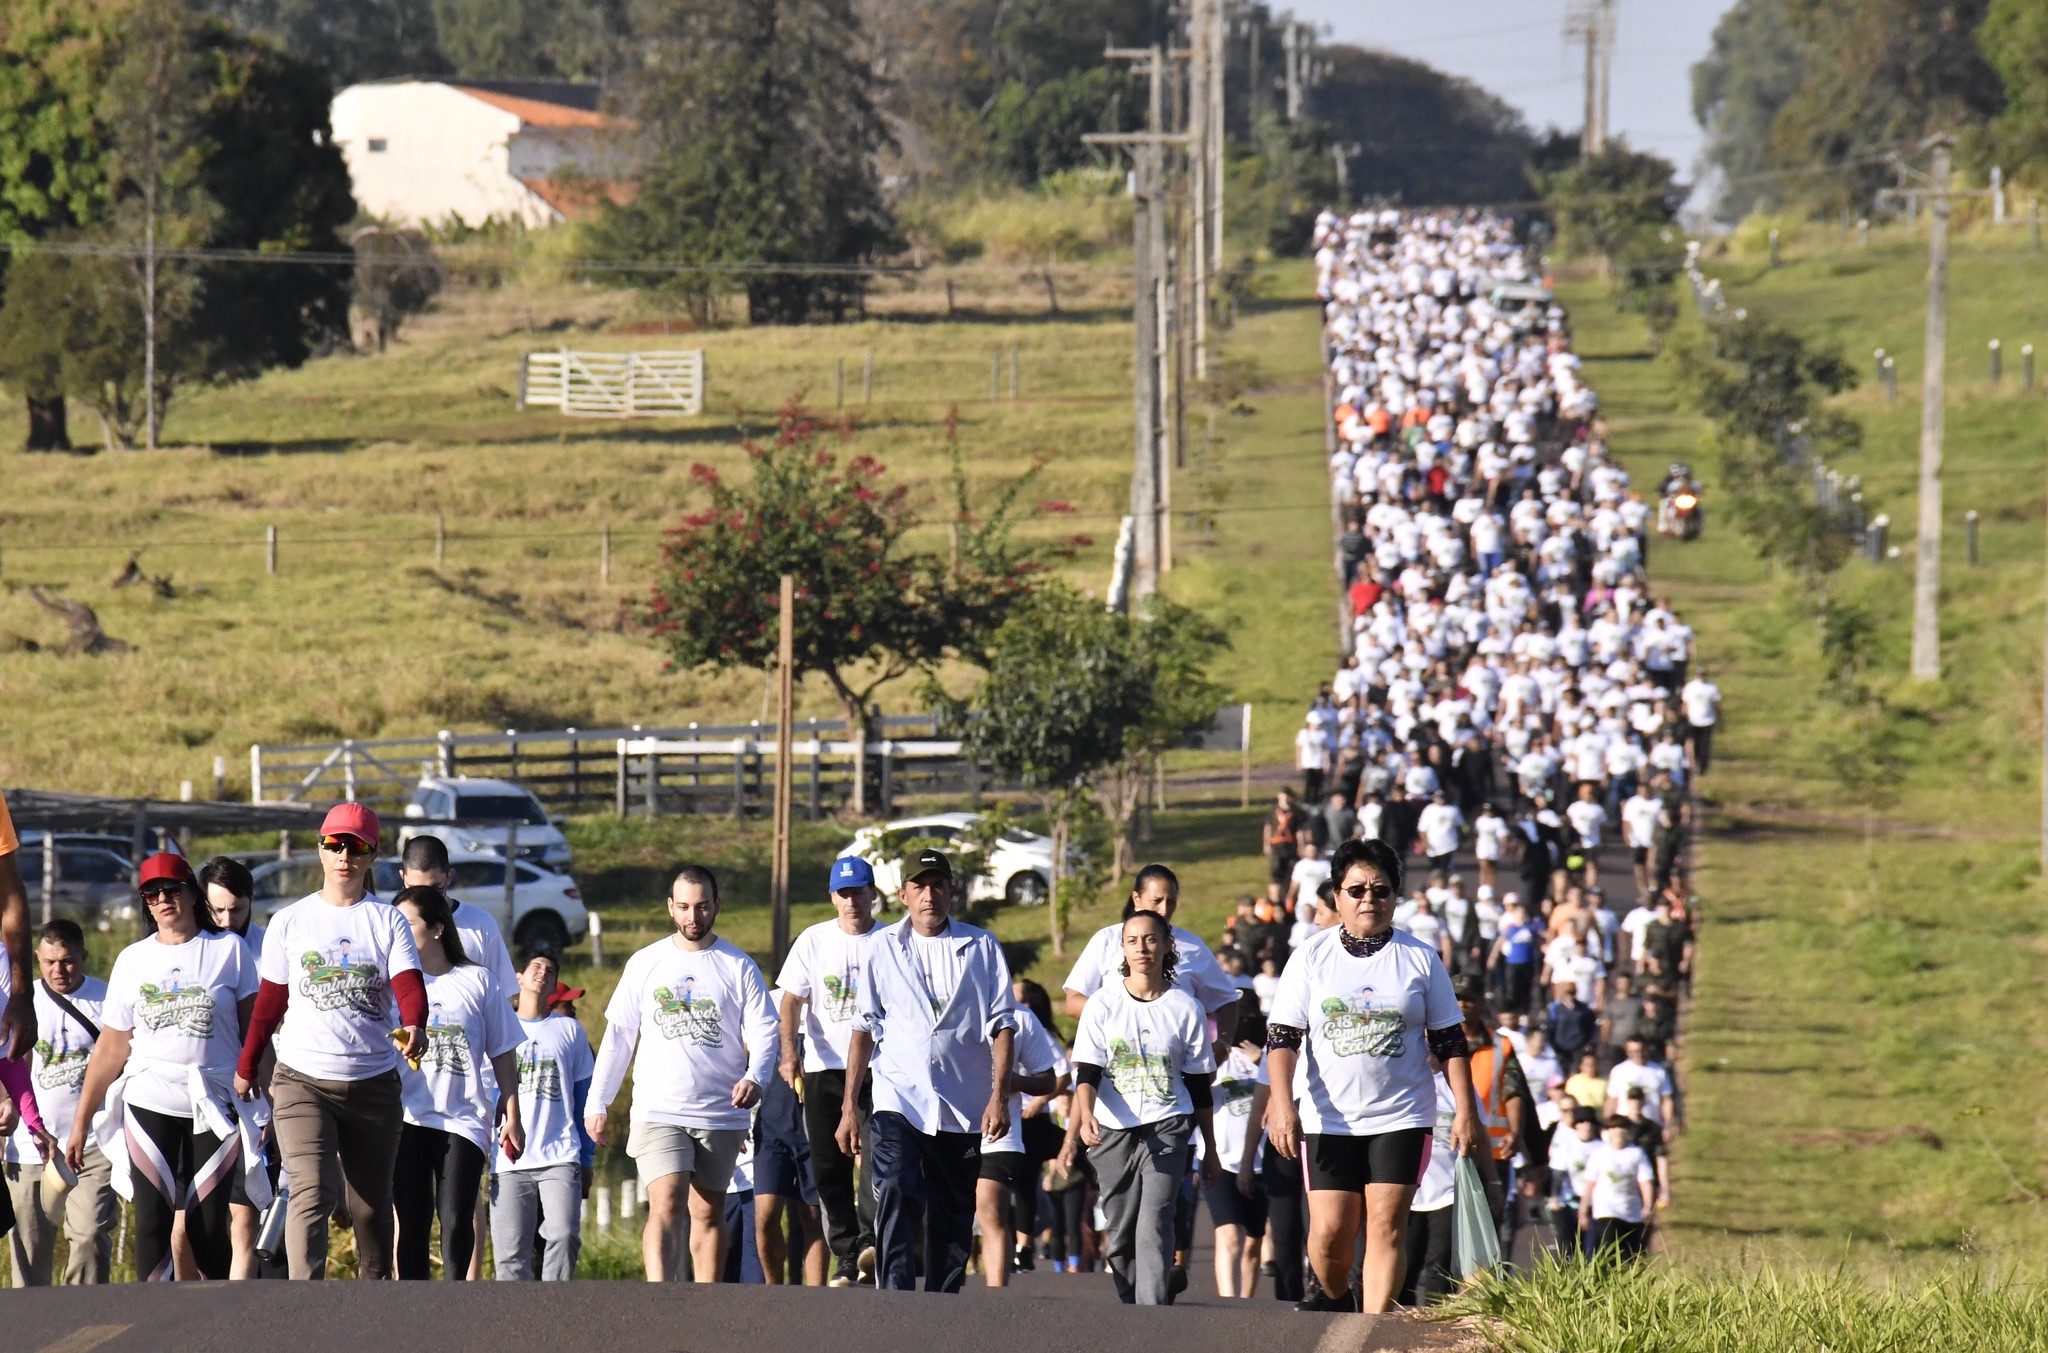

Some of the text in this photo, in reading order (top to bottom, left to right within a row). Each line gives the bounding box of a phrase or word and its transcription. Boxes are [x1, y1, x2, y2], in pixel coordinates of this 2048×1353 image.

[300, 972, 385, 998] Caminhada
[135, 990, 216, 1018] Caminhada
[144, 1006, 216, 1034] Ecológica
[1323, 1016, 1407, 1041] Caminhada
